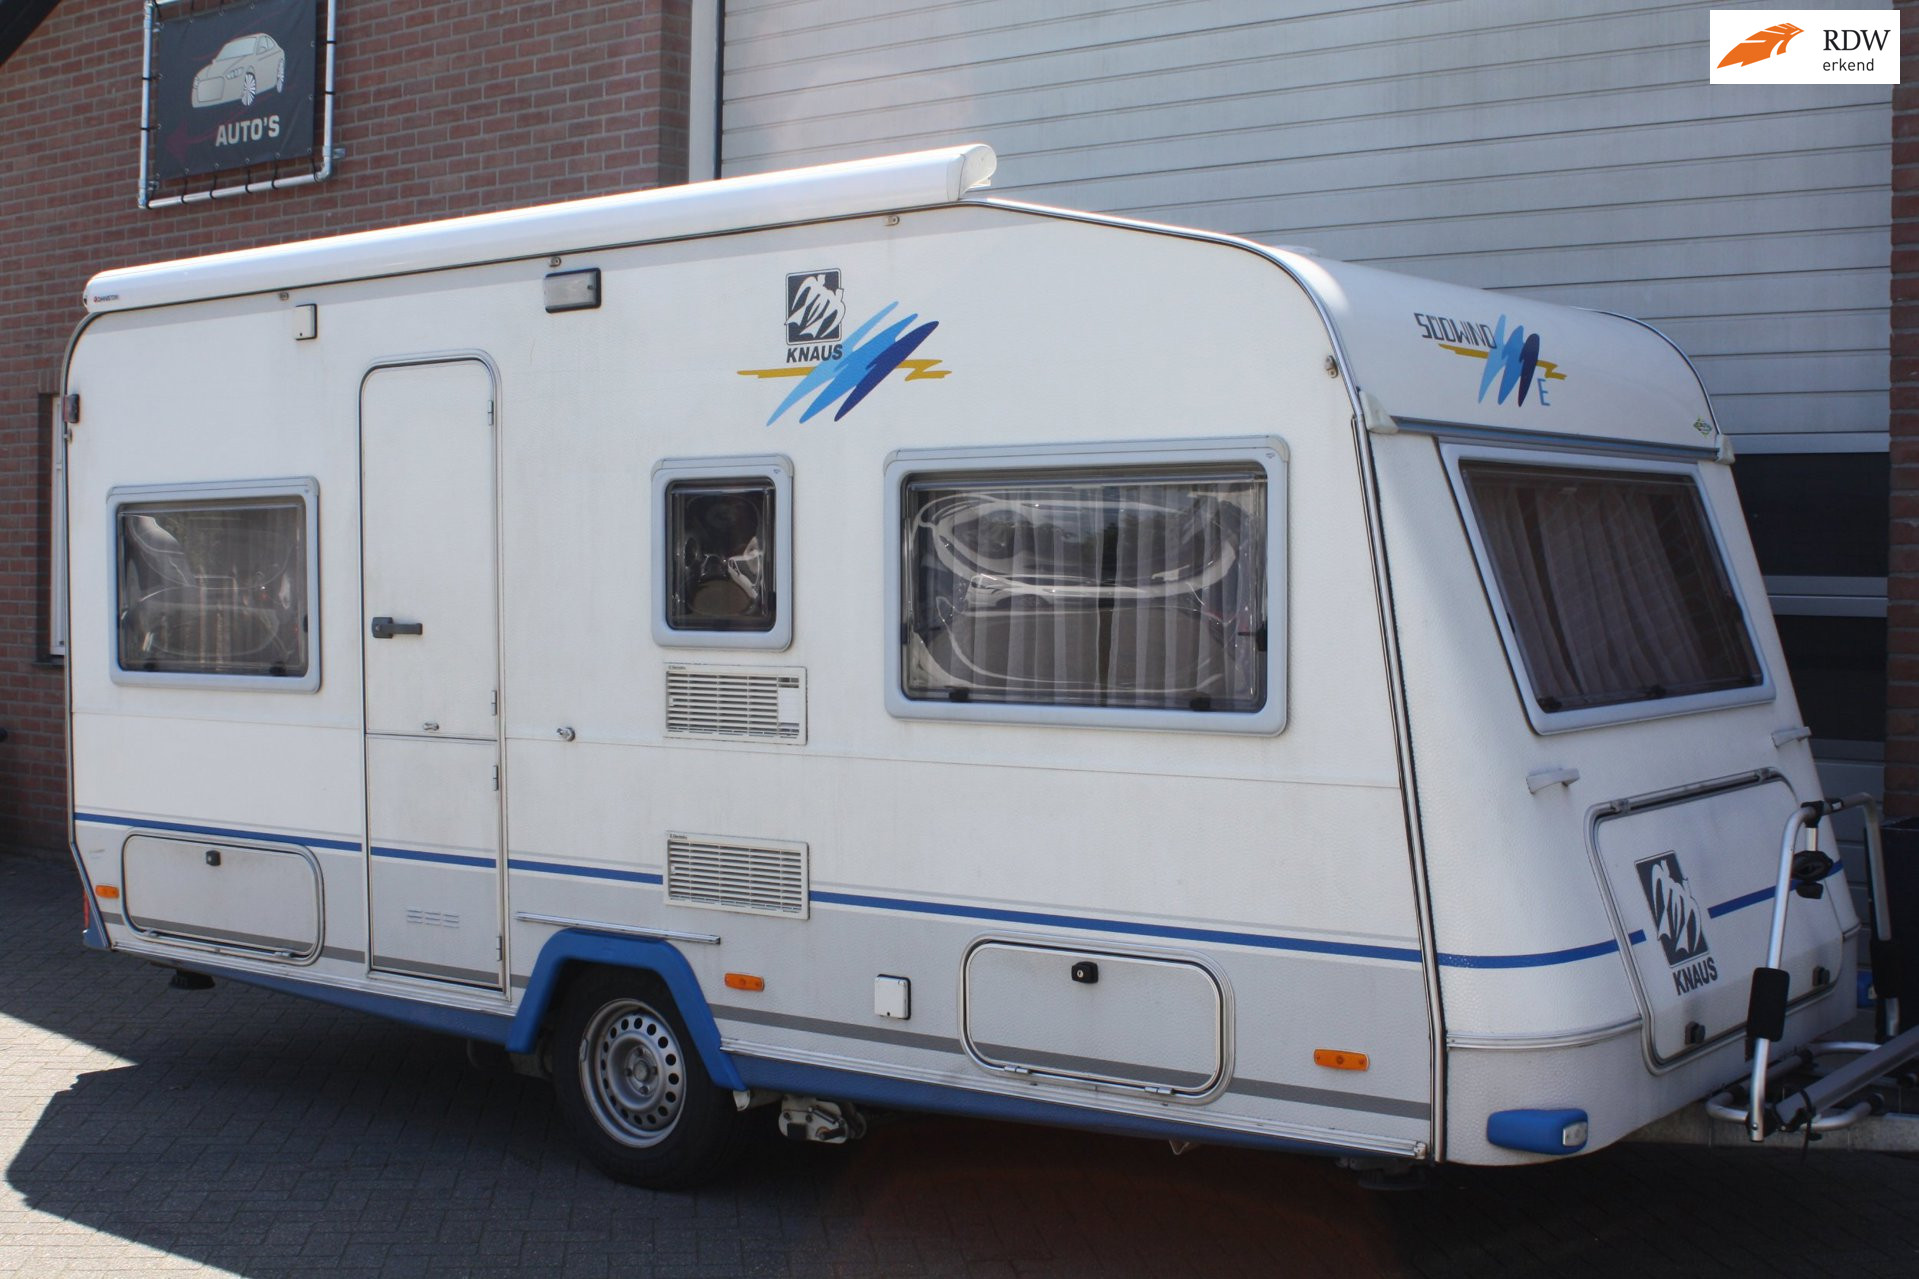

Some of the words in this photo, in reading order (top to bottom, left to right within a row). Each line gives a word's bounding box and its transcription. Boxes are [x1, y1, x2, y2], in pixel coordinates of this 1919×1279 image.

[215, 114, 280, 147] AUTO'S
[786, 343, 843, 363] KNAUS
[1537, 378, 1550, 406] E
[1672, 956, 1718, 996] KNAUS
